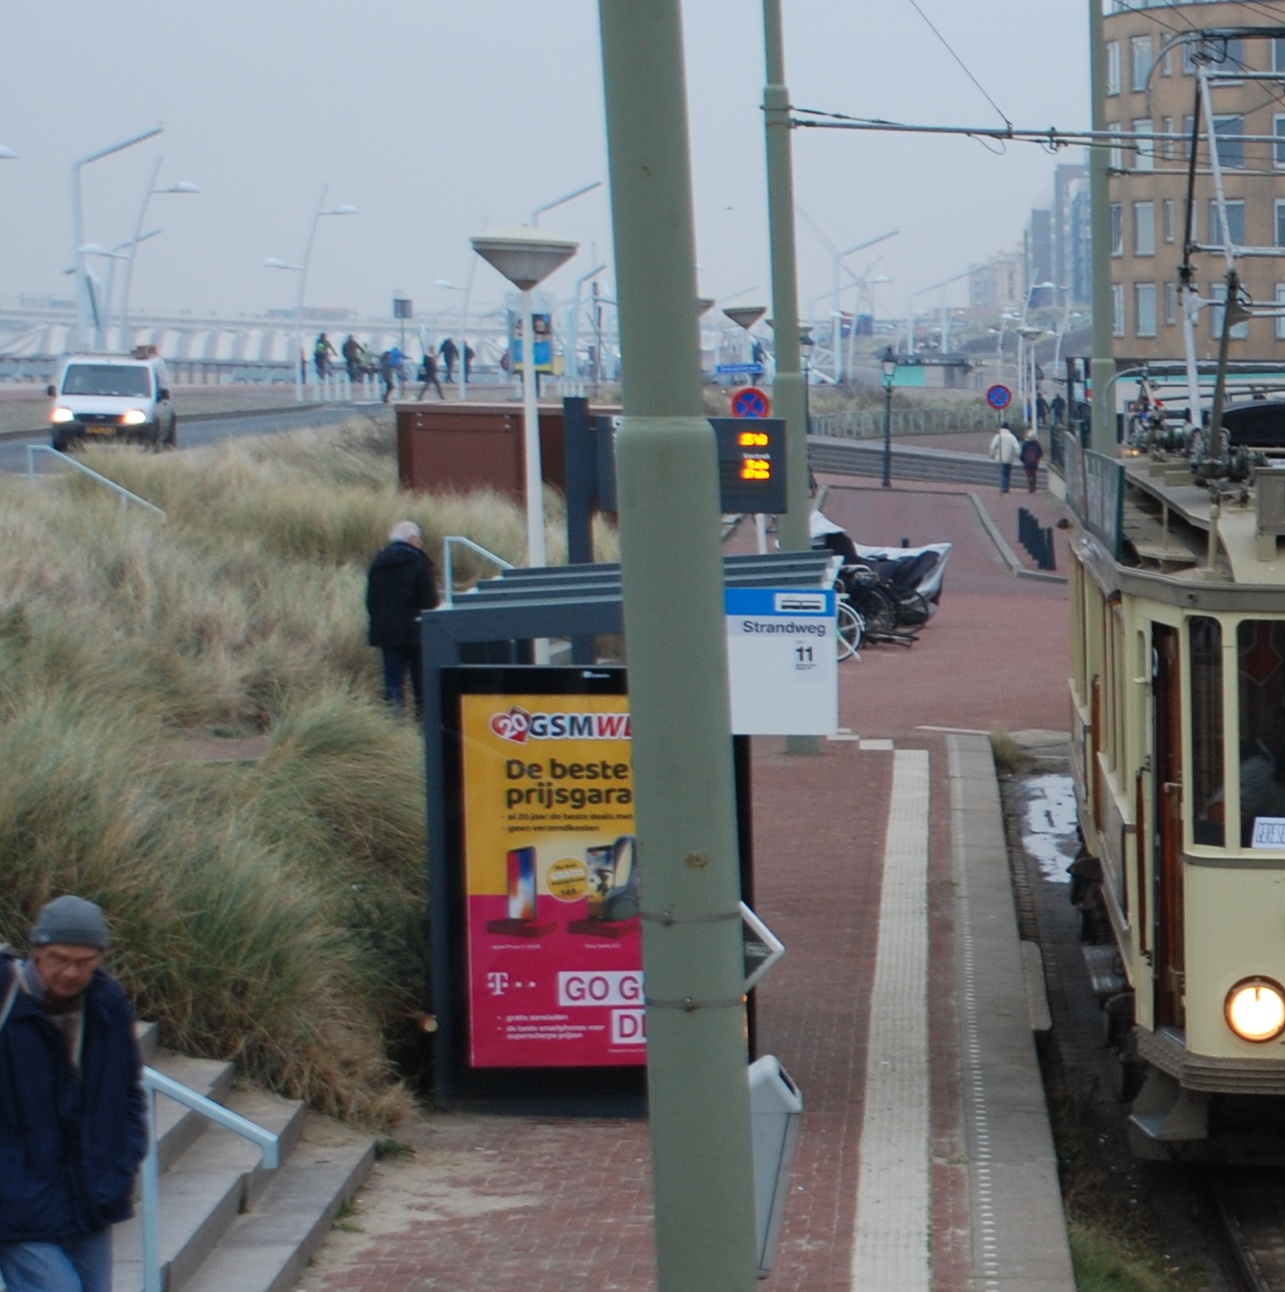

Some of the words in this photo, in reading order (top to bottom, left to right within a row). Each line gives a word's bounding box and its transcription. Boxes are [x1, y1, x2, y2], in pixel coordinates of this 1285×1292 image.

[743, 620, 826, 637] Strandweg
[795, 646, 813, 662] 11
[500, 713, 528, 738] 20
[506, 759, 543, 780] De
[550, 758, 629, 780] beste
[565, 977, 610, 1001] GO
[619, 976, 644, 1000] G
